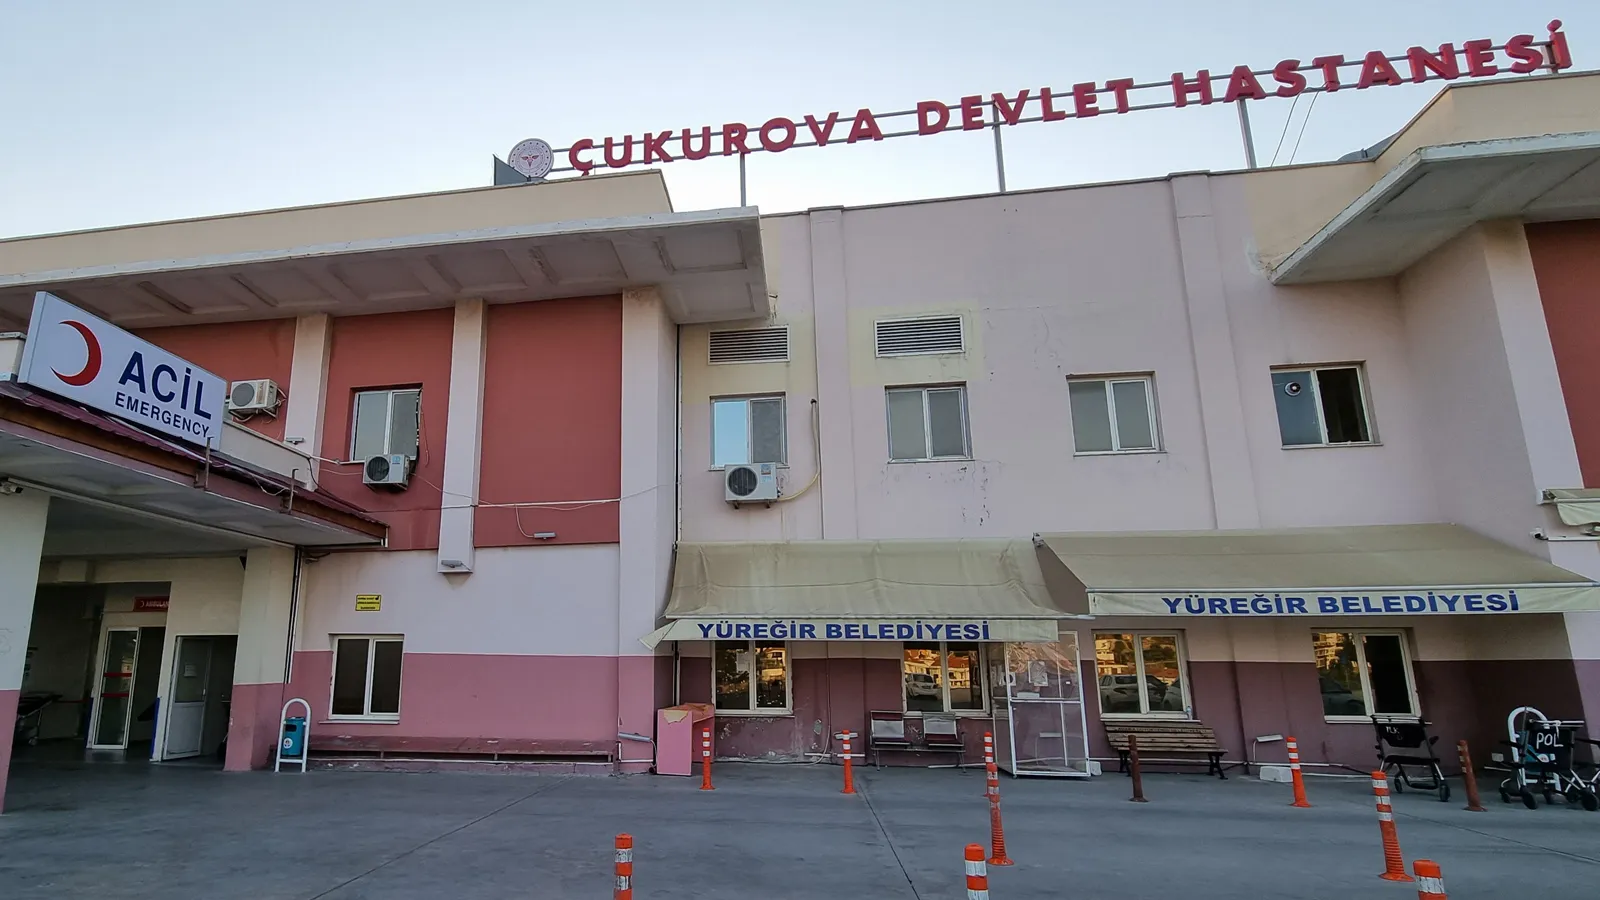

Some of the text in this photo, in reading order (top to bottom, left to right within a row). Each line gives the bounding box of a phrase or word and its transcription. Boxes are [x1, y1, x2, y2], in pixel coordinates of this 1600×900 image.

[568, 18, 1573, 176] ÇUKUROVA DEVLET HASTANESİ
[118, 350, 212, 420] ACİL
[114, 391, 210, 438] EMERGENCY
[1160, 590, 1519, 614] YÜREĞİR BELEDİYESİ
[697, 620, 990, 640] YÜREĞİR BELEDİYESİ
[1536, 732, 1564, 750] POL
